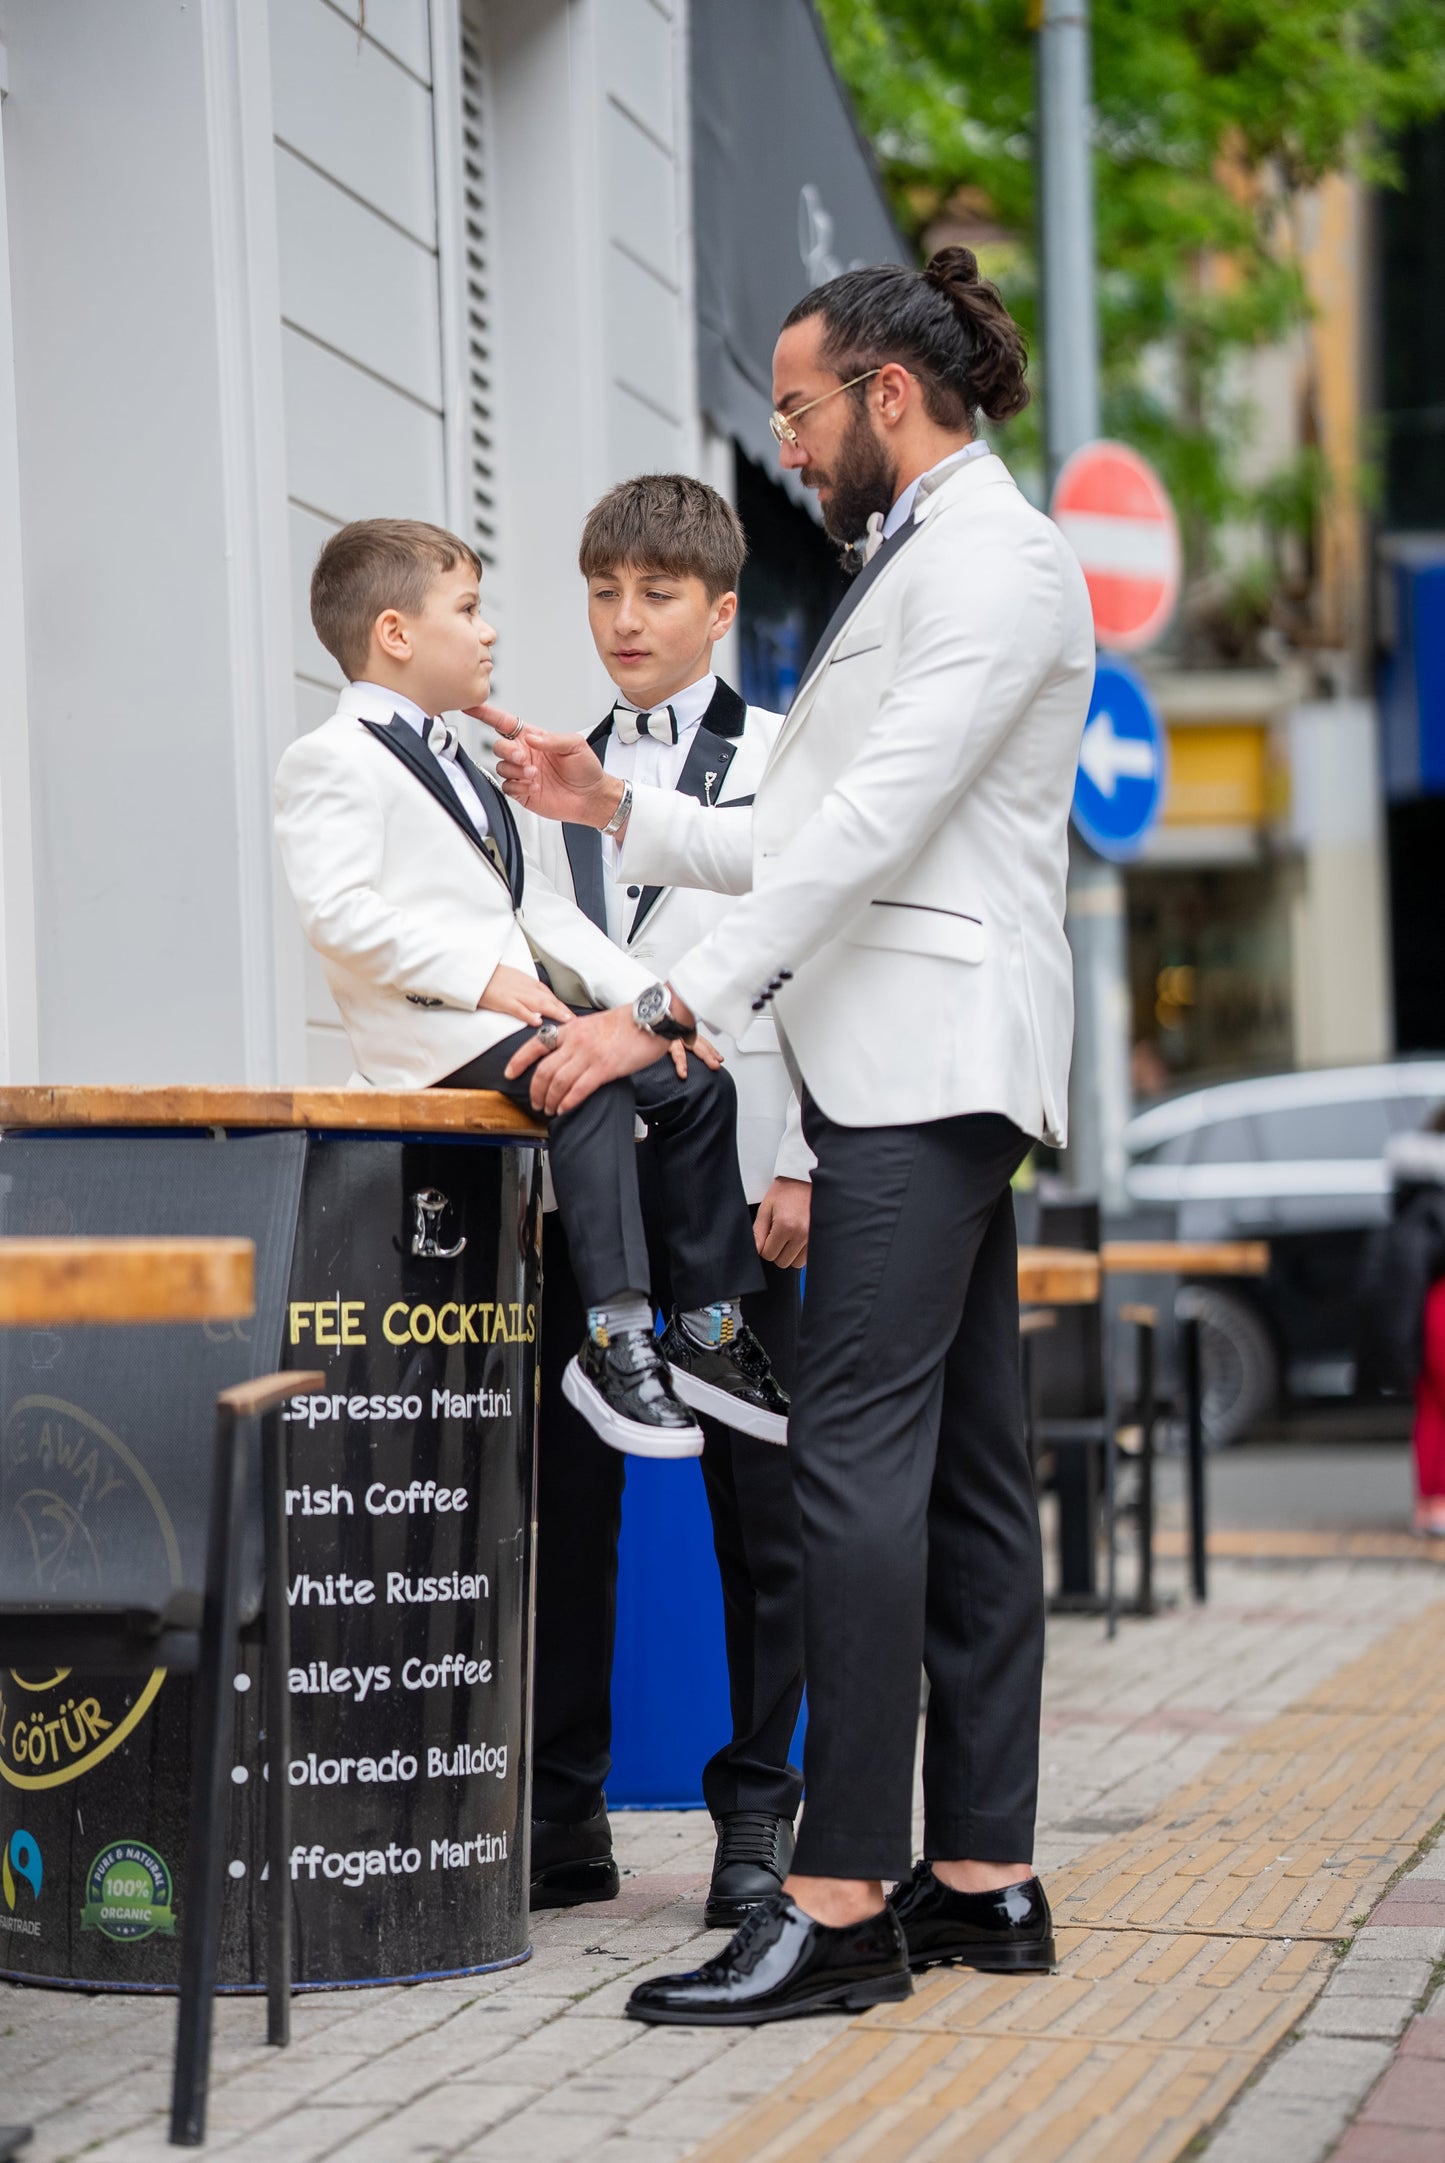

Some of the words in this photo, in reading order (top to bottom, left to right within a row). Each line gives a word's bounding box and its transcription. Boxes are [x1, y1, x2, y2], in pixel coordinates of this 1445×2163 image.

[382, 1302, 535, 1345] COCKTAILS
[431, 1388, 512, 1419] Martini
[284, 1484, 354, 1516] rish
[364, 1480, 469, 1516] Coffee
[387, 1570, 490, 1604] Russian
[288, 1661, 391, 1702] aileys
[402, 1653, 493, 1690] Coffee
[12, 1697, 113, 1765] GÖTÜR
[263, 1750, 418, 1786] olorado
[427, 1743, 508, 1779] Bulldog
[94, 1853, 116, 1882] PURE
[126, 1848, 165, 1887] NATURAL
[260, 1843, 421, 1887] ffogato
[430, 1830, 507, 1871] Martini
[106, 1878, 150, 1898] 100%
[100, 1907, 153, 1922] ORGANIC
